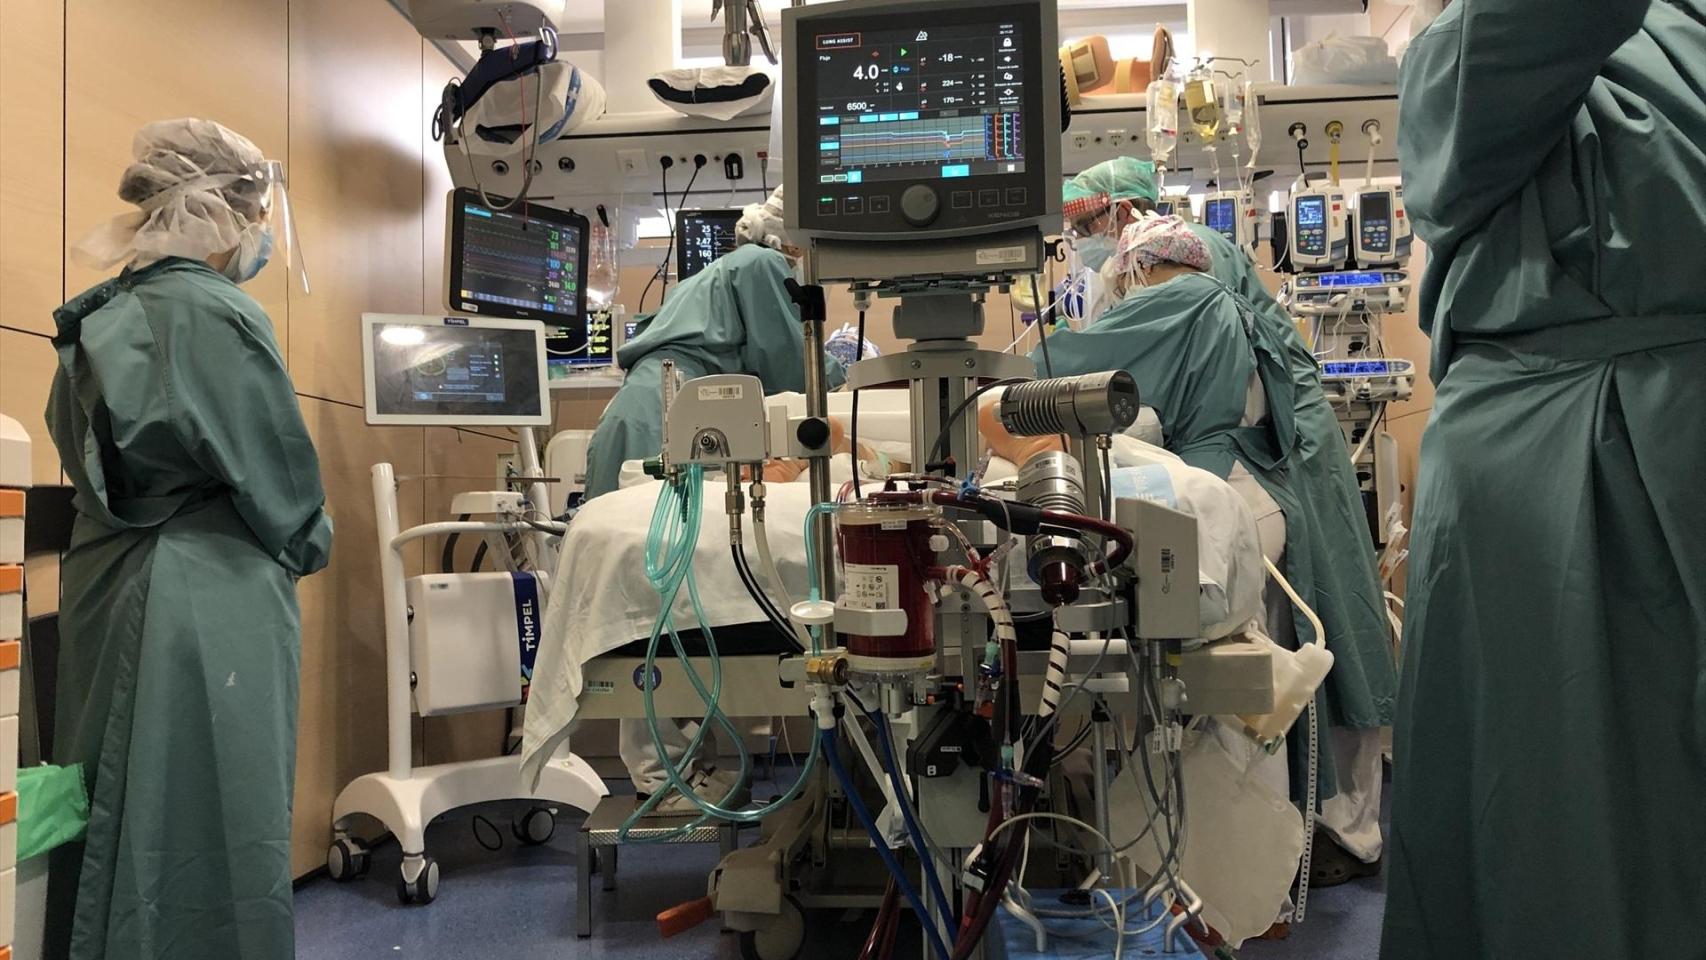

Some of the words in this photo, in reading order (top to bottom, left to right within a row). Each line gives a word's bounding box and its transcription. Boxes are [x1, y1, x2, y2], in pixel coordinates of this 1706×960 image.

[853, 64, 879, 80] 4.0
[846, 102, 867, 110] 6500
[702, 225, 711, 233] 25
